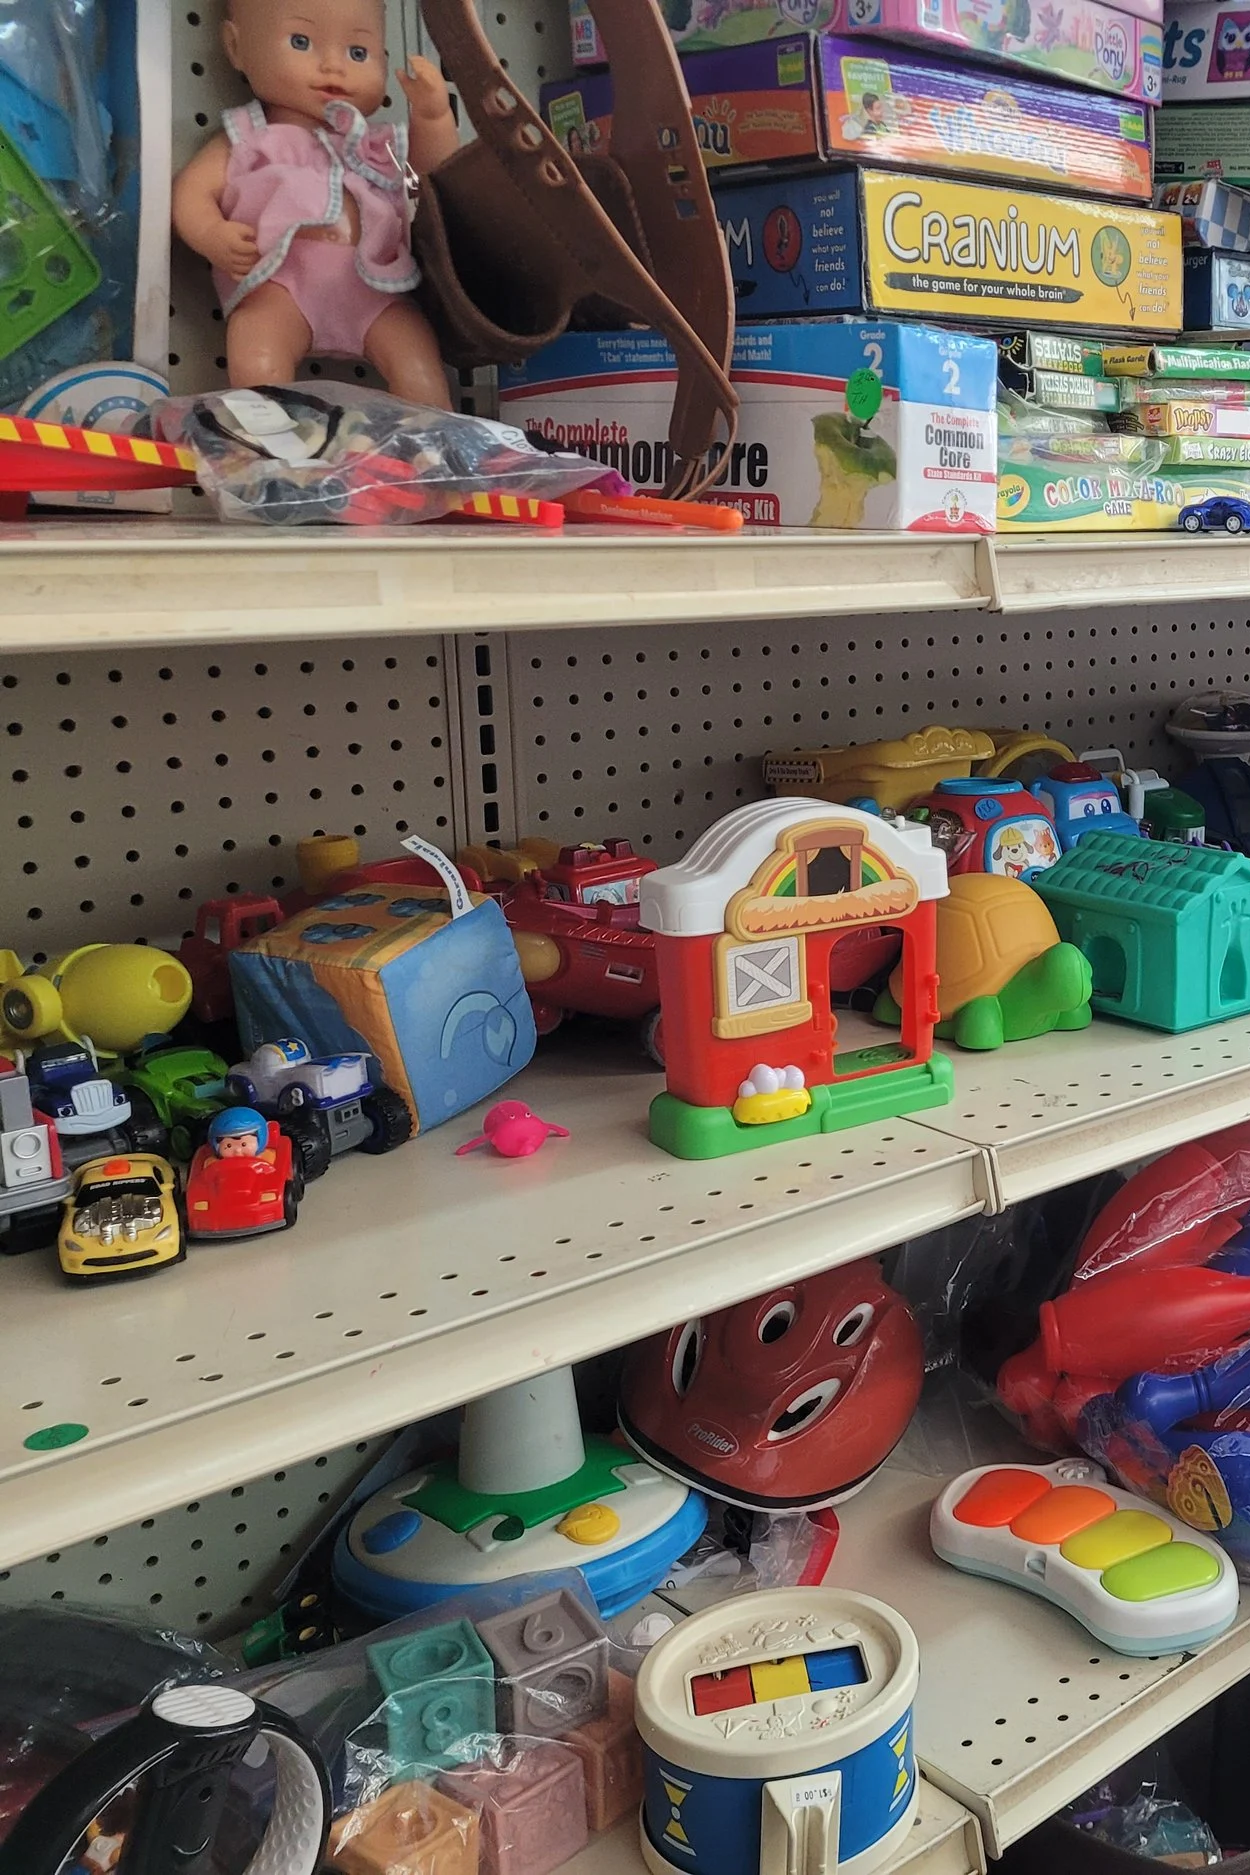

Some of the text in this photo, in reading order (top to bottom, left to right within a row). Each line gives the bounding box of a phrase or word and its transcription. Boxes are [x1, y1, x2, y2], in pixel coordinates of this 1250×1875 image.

[1146, 76, 1158, 92] 3+
[1163, 74, 1187, 85] ni-Rug
[820, 207, 834, 217] not
[812, 224, 844, 237] believe
[812, 243, 846, 254] what your
[1146, 239, 1160, 249] not
[815, 260, 845, 273] friends
[1139, 254, 1168, 266] believe
[1136, 271, 1170, 281] what your
[815, 278, 846, 292] can do!
[912, 274, 929, 288] the
[932, 279, 960, 293] game
[963, 279, 979, 293] for
[980, 283, 1004, 296] your
[1006, 283, 1036, 298] whole
[1139, 285, 1167, 297] friends
[1139, 303, 1166, 313] can do!
[757, 333, 772, 345] and
[860, 329, 885, 341] Grade
[597, 336, 668, 350] Everything you need
[625, 351, 664, 363] statements
[749, 350, 772, 361] Math!
[1035, 337, 1082, 364] STATES
[863, 343, 884, 378] 2
[1109, 354, 1147, 364] Flash Cards
[1167, 356, 1233, 371] Multiplication
[942, 359, 961, 396] 2
[1040, 375, 1095, 396] METRIC SYSTEM
[930, 412, 945, 425] The
[1174, 408, 1214, 431] Dropsy
[525, 418, 542, 434] The
[543, 417, 628, 446] Complete
[925, 425, 985, 450] Common
[939, 447, 971, 469] Core
[1208, 444, 1238, 461] CRAZY
[944, 469, 972, 481] Standards
[995, 484, 1021, 500] rayola
[1044, 475, 1186, 508] COLOR MIX-A-ROO
[754, 499, 775, 521] Kit
[1104, 500, 1132, 516] GAME
[291, 1087, 304, 1106] 8
[89, 1182, 111, 1190] ROAD
[687, 1423, 736, 1453] ProRider
[804, 1788, 828, 1800] $1.00
